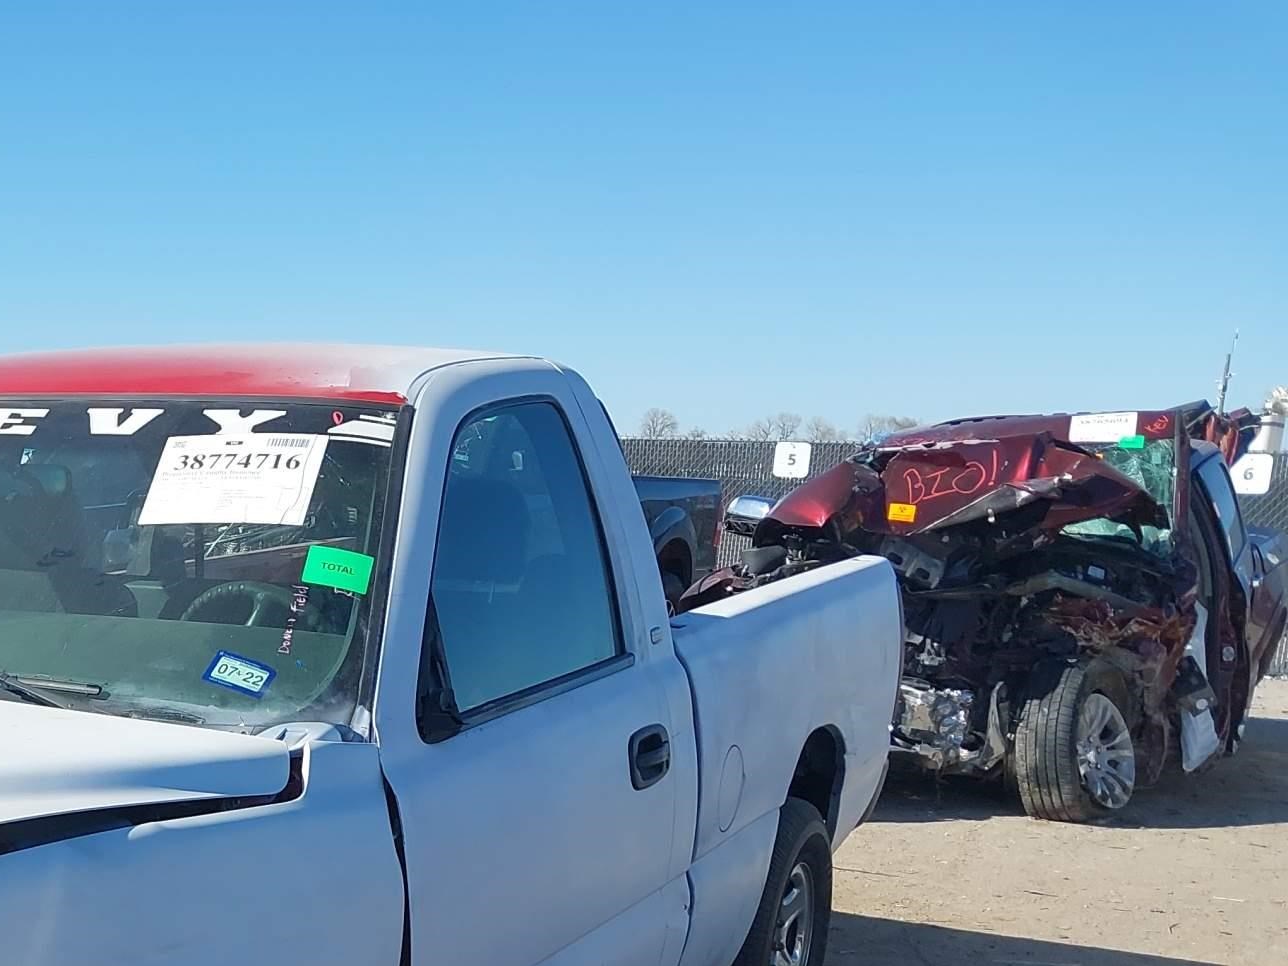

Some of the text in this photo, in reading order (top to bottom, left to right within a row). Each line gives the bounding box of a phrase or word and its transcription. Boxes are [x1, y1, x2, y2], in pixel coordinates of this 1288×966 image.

[173, 452, 305, 472] 38774716
[787, 453, 797, 466] 5
[903, 449, 1000, 505] BIO!
[1243, 467, 1254, 481] 6
[320, 562, 356, 576] TOTAL
[217, 663, 237, 676] 07
[243, 671, 264, 687] 22
